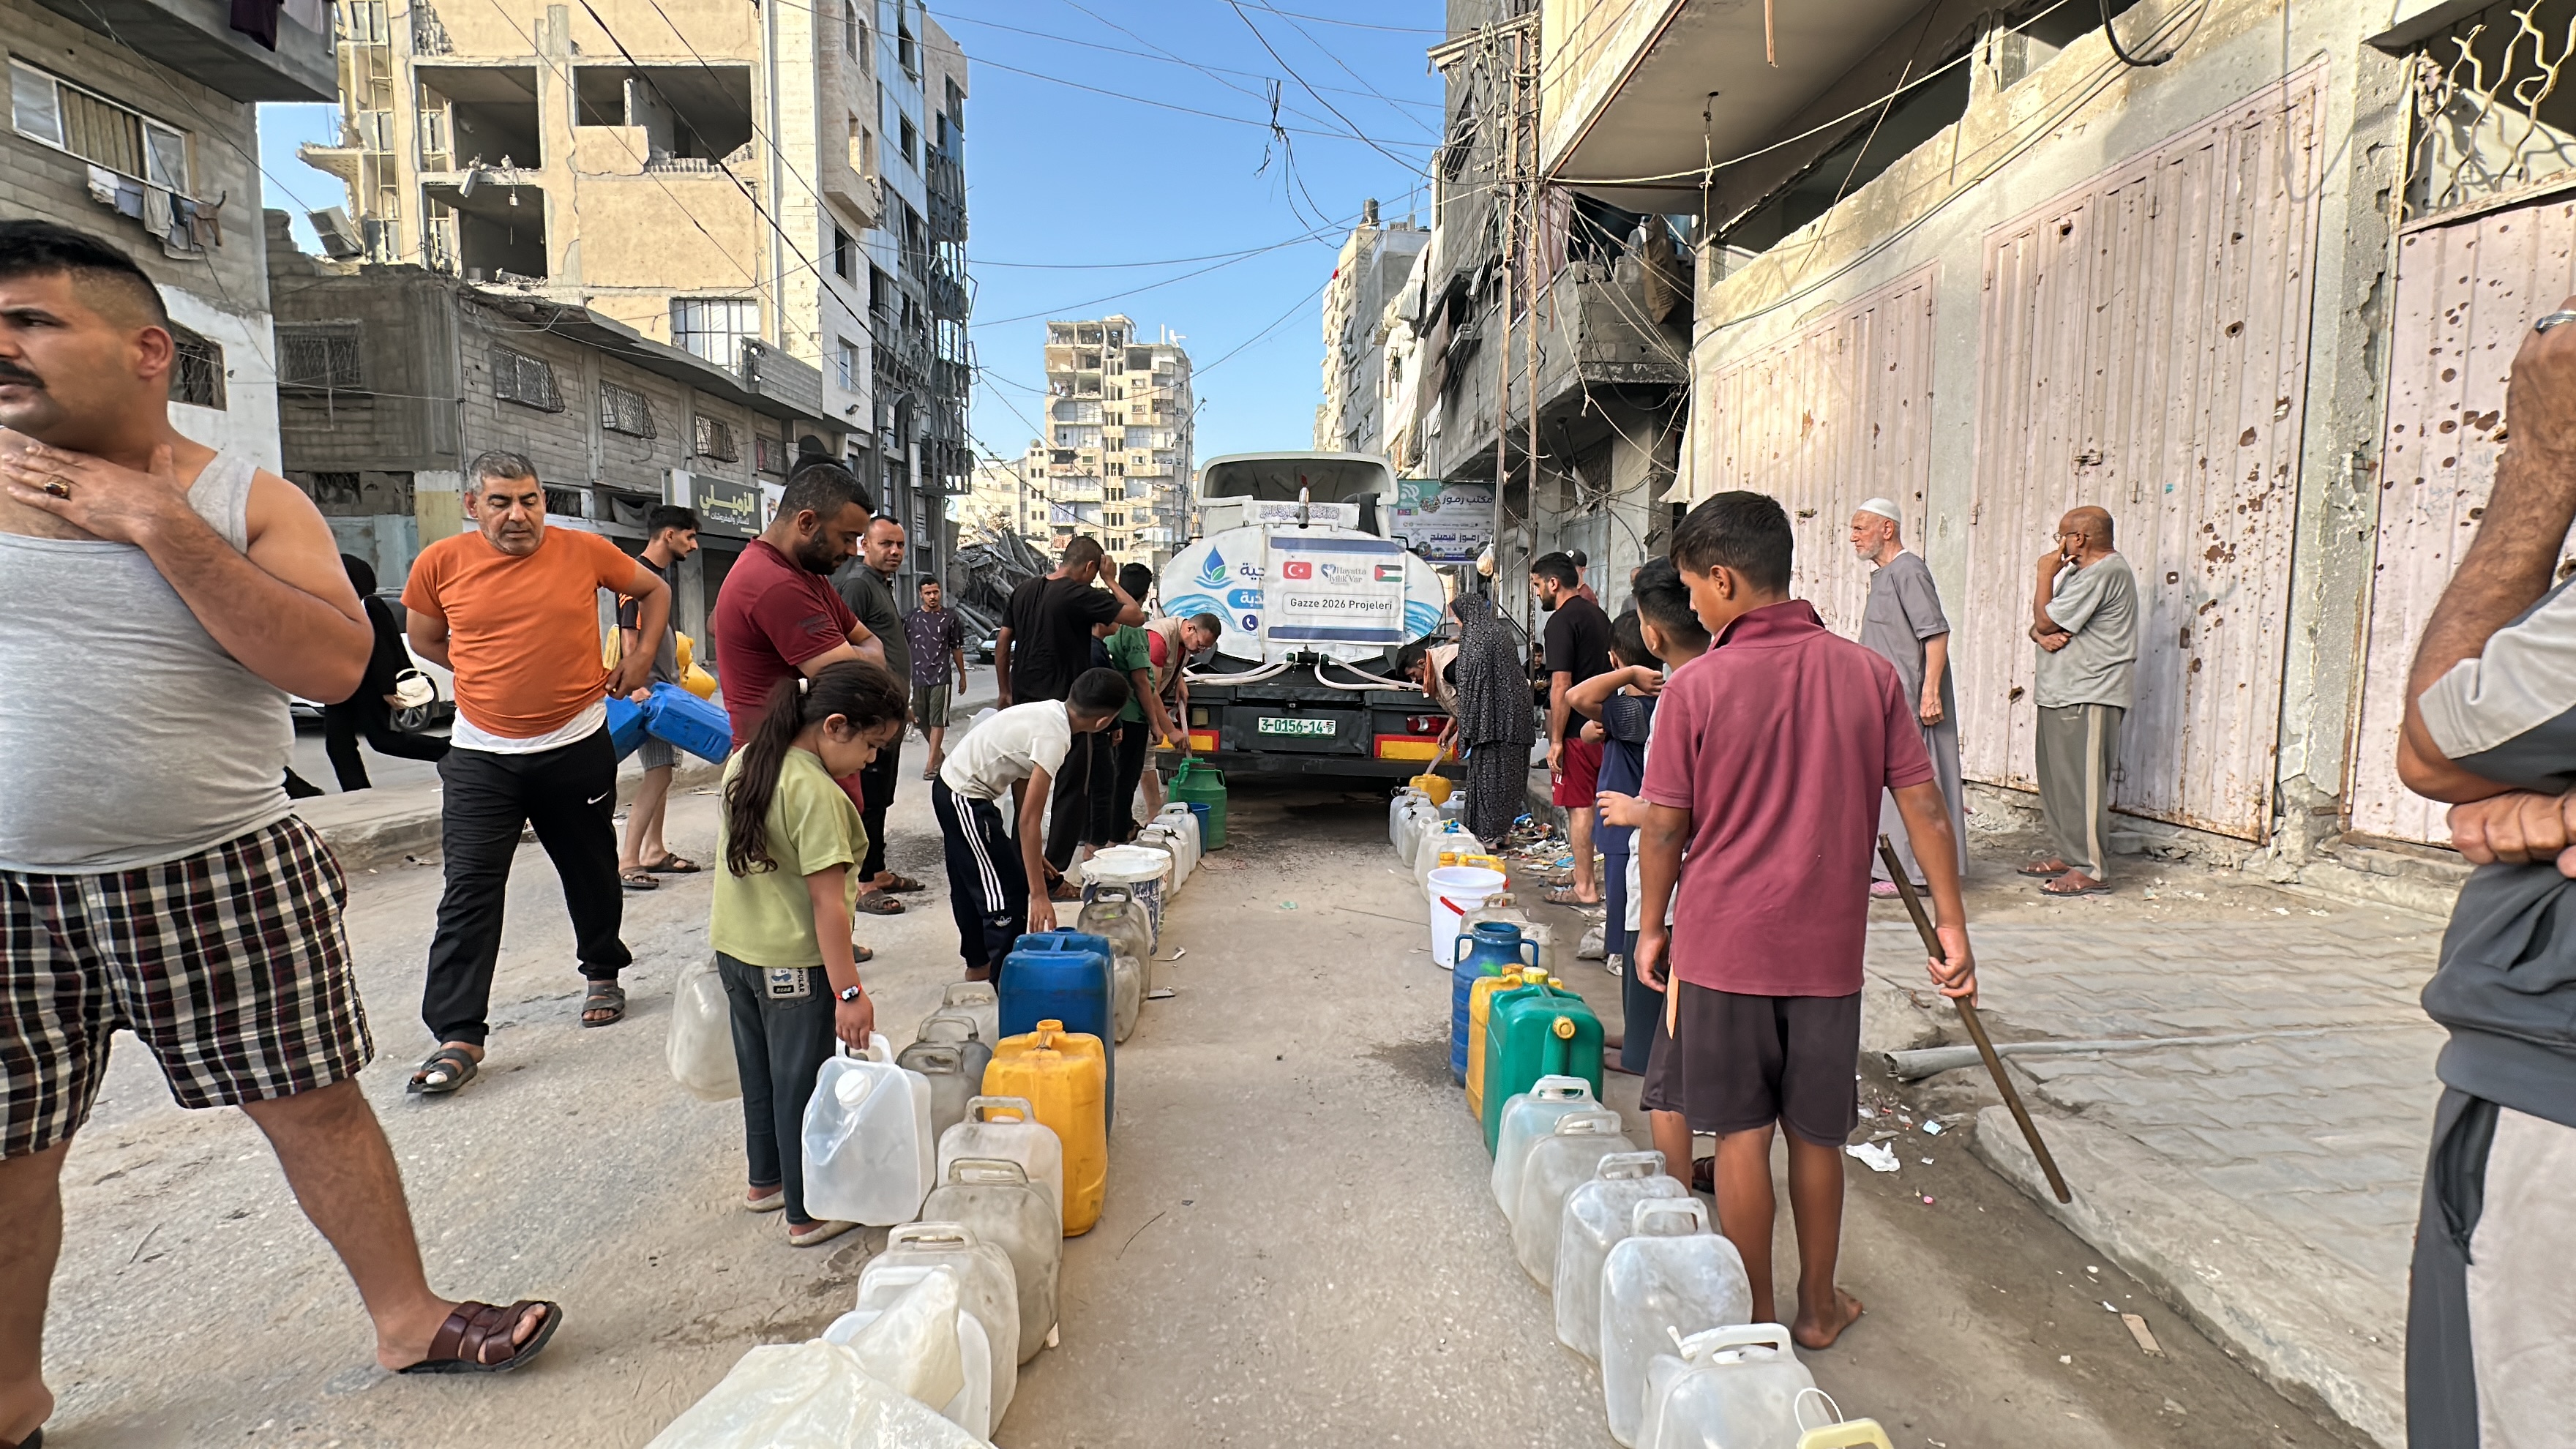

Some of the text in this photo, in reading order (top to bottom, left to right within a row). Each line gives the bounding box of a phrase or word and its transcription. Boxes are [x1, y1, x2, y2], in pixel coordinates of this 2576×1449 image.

[700, 484, 754, 516] الزميلي
[1442, 495, 1493, 506] مكتب رموز
[1458, 533, 1480, 543] رموز
[1337, 566, 1366, 576] Hayatta
[1349, 574, 1363, 583] Var
[1290, 598, 1392, 611] Gazze 2026 Projeleri
[1261, 719, 1324, 733] 3-0156-14
